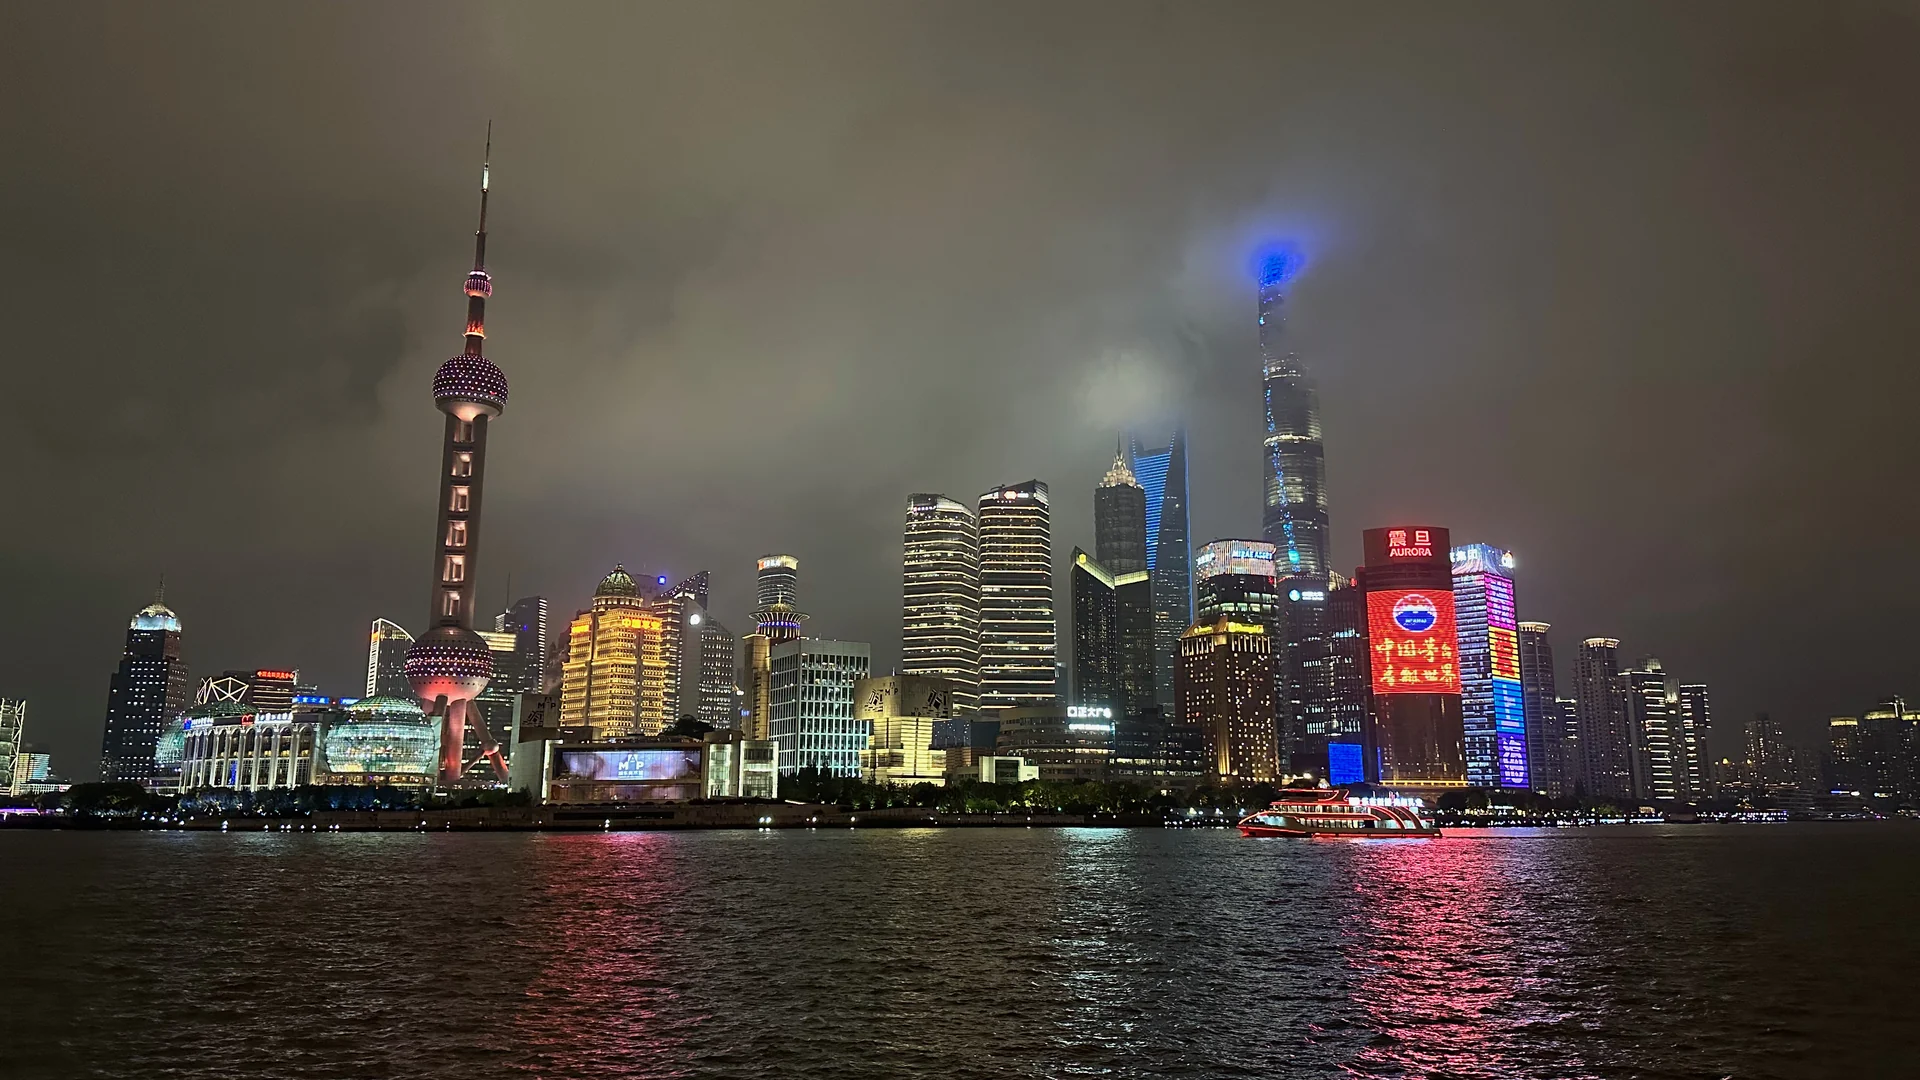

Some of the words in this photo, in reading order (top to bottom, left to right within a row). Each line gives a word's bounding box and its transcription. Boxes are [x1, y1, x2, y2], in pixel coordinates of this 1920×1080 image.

[1389, 530, 1432, 547] 震旦
[1232, 549, 1254, 558] MIRAE
[1254, 551, 1273, 560] ASSET
[1389, 547, 1433, 557] AURORA
[1375, 637, 1452, 663] 中国茅台
[618, 753, 644, 771] MAP
